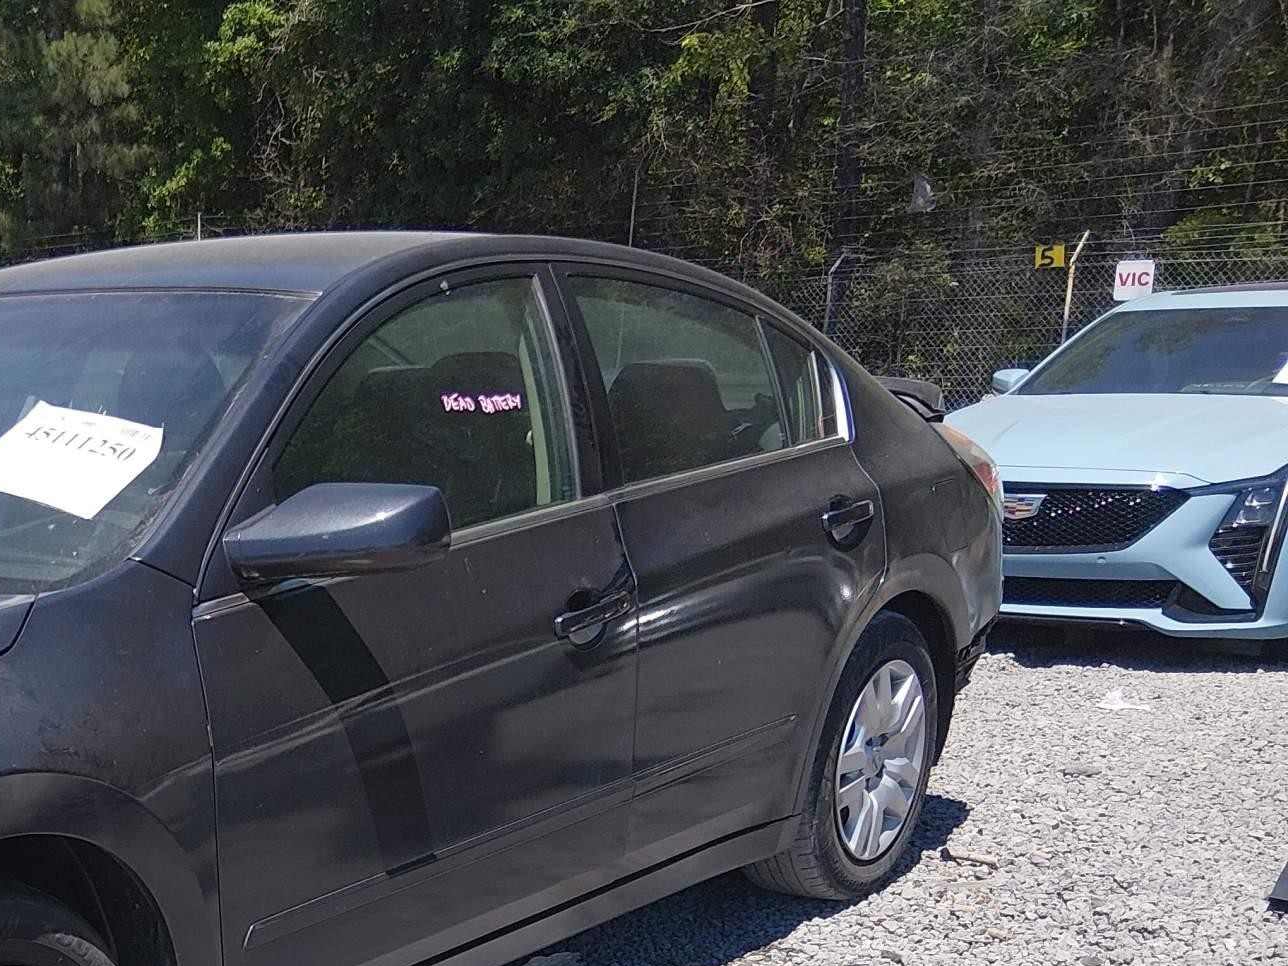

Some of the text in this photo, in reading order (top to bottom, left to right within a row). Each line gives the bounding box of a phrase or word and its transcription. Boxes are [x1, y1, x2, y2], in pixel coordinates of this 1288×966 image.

[1039, 247, 1055, 267] 5
[1118, 271, 1150, 287] VIC
[441, 392, 522, 414] DEAD BATTERY
[25, 425, 137, 461] 45111250
